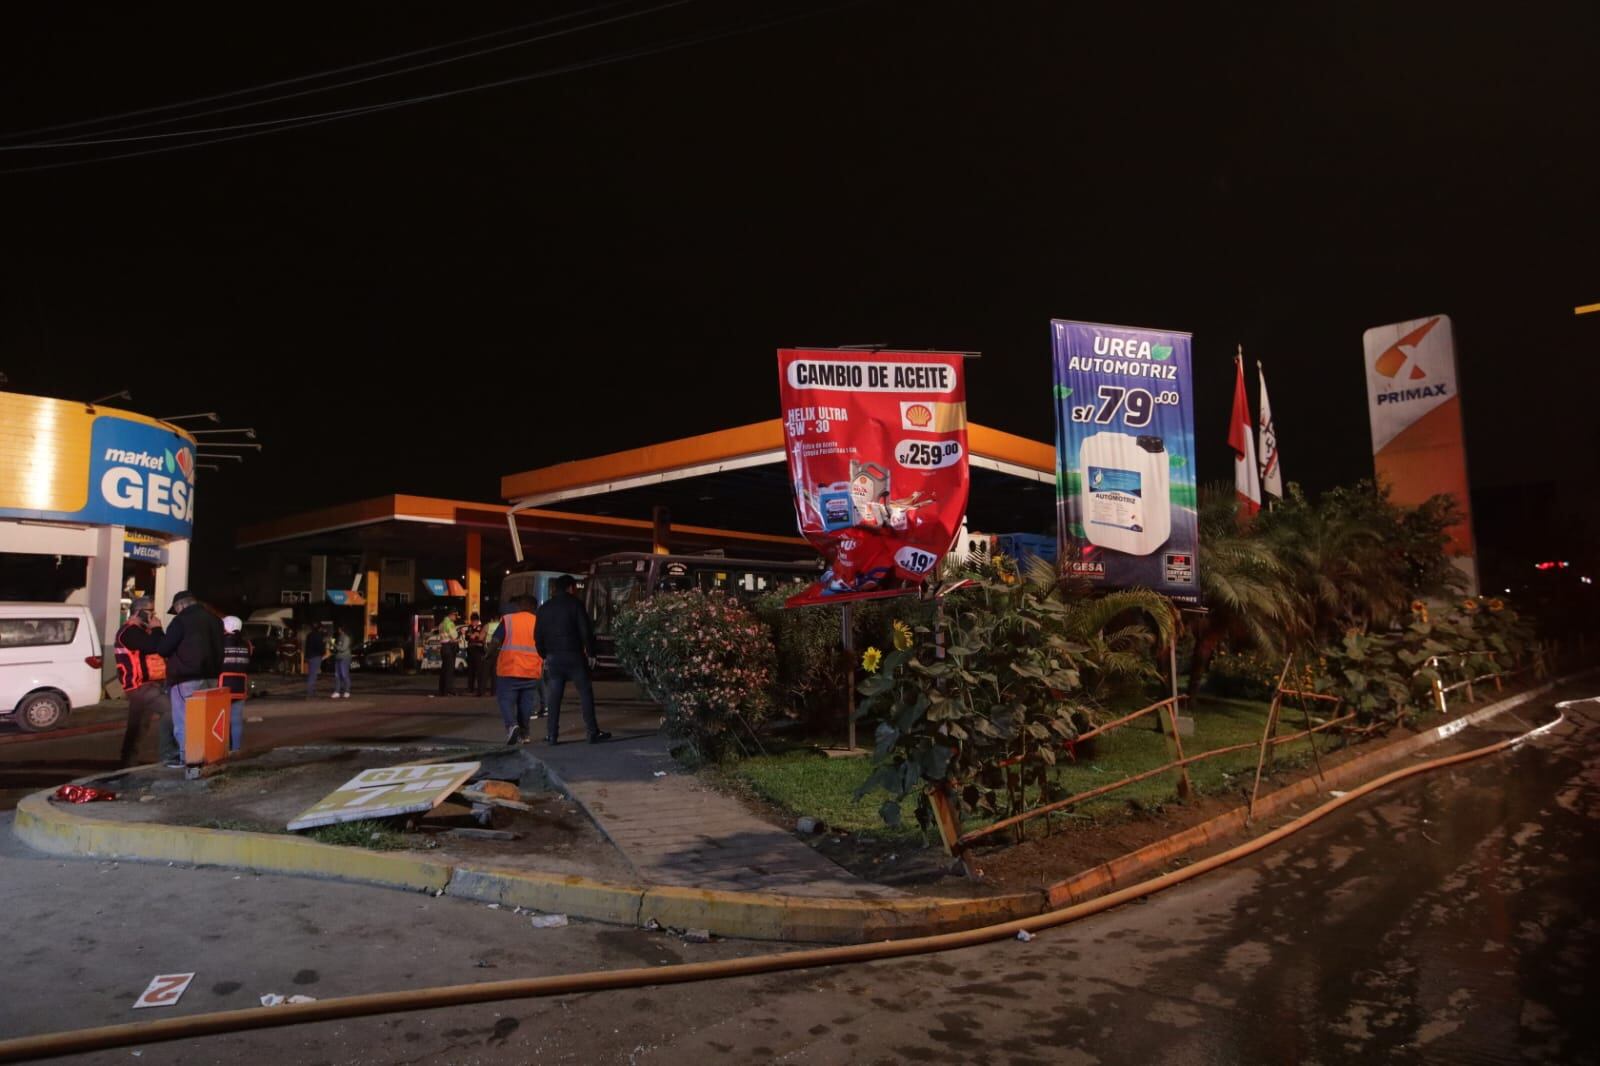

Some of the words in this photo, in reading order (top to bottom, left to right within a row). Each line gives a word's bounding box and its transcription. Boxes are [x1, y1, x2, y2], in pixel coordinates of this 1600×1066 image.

[1094, 336, 1151, 360] UREA
[796, 363, 862, 388] CAMBIO
[868, 365, 888, 388] DE
[894, 366, 948, 389] ACEITE
[1069, 356, 1178, 379] AUTOMOTRIZ
[1377, 384, 1446, 405] PRIMAX
[788, 407, 815, 423] HELIX
[818, 406, 848, 421] ULTRA
[789, 421, 805, 437] 5W
[815, 420, 830, 433] 30
[104, 448, 164, 471] market
[1095, 493, 1136, 504] AUTOMOTRIZ
[1072, 562, 1103, 573] GESA
